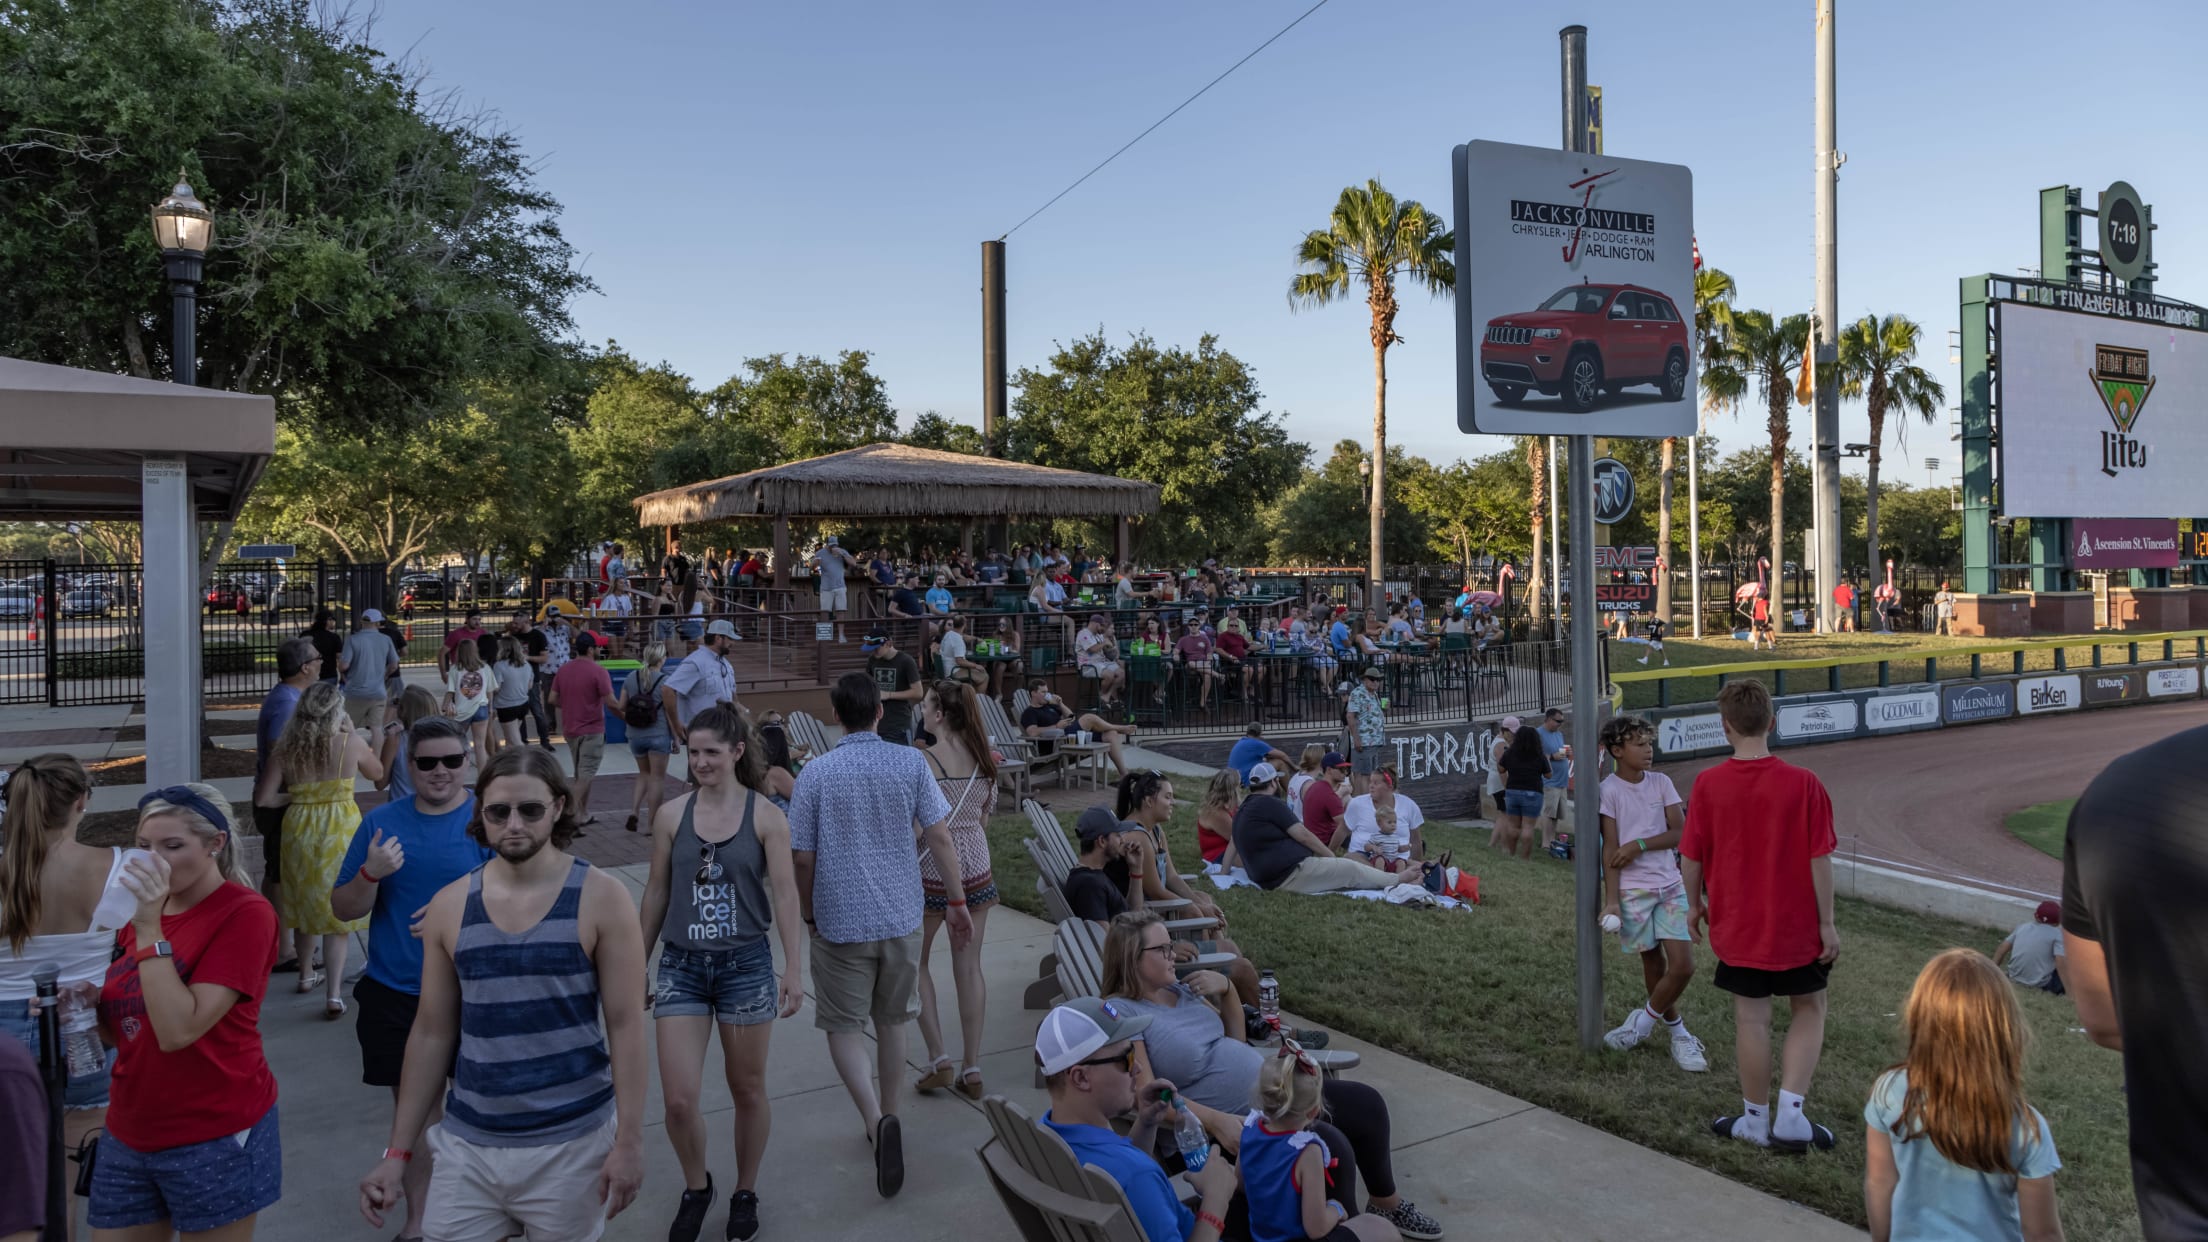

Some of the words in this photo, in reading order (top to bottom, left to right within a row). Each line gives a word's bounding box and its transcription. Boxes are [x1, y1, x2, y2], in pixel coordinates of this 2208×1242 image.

[1512, 202, 1655, 234] JACKSONVILLE
[1512, 223, 1561, 238] CHRYSLER
[1593, 231, 1629, 245] DODGE
[1634, 235, 1655, 247] RAM
[2111, 220, 2137, 245] 7:18
[1585, 243, 1655, 263] ARLINGTON
[2034, 286, 2056, 304] 121
[2060, 290, 2133, 316] FINANCIAL
[2098, 352, 2124, 374] FRIDAY
[2126, 355, 2147, 376] NIGHT
[2100, 430, 2147, 478] Lites
[2094, 536, 2131, 550] Ascension
[2132, 536, 2143, 550] St.
[2143, 536, 2176, 550] Vincent's
[1596, 586, 1650, 600] SUZU
[1598, 601, 1641, 610] TRUCKS
[1882, 701, 1924, 721] GOODWILL
[1952, 709, 1985, 720] PHYSICIAN
[1986, 706, 2007, 717] GROUP
[1686, 720, 1722, 732] JACKSONVILL
[1801, 721, 1823, 732] Patriot
[1823, 721, 1836, 731] Rail
[1391, 729, 1491, 780] TERRAC
[692, 881, 729, 906] jax
[698, 900, 730, 921] ice
[688, 921, 731, 940] men
